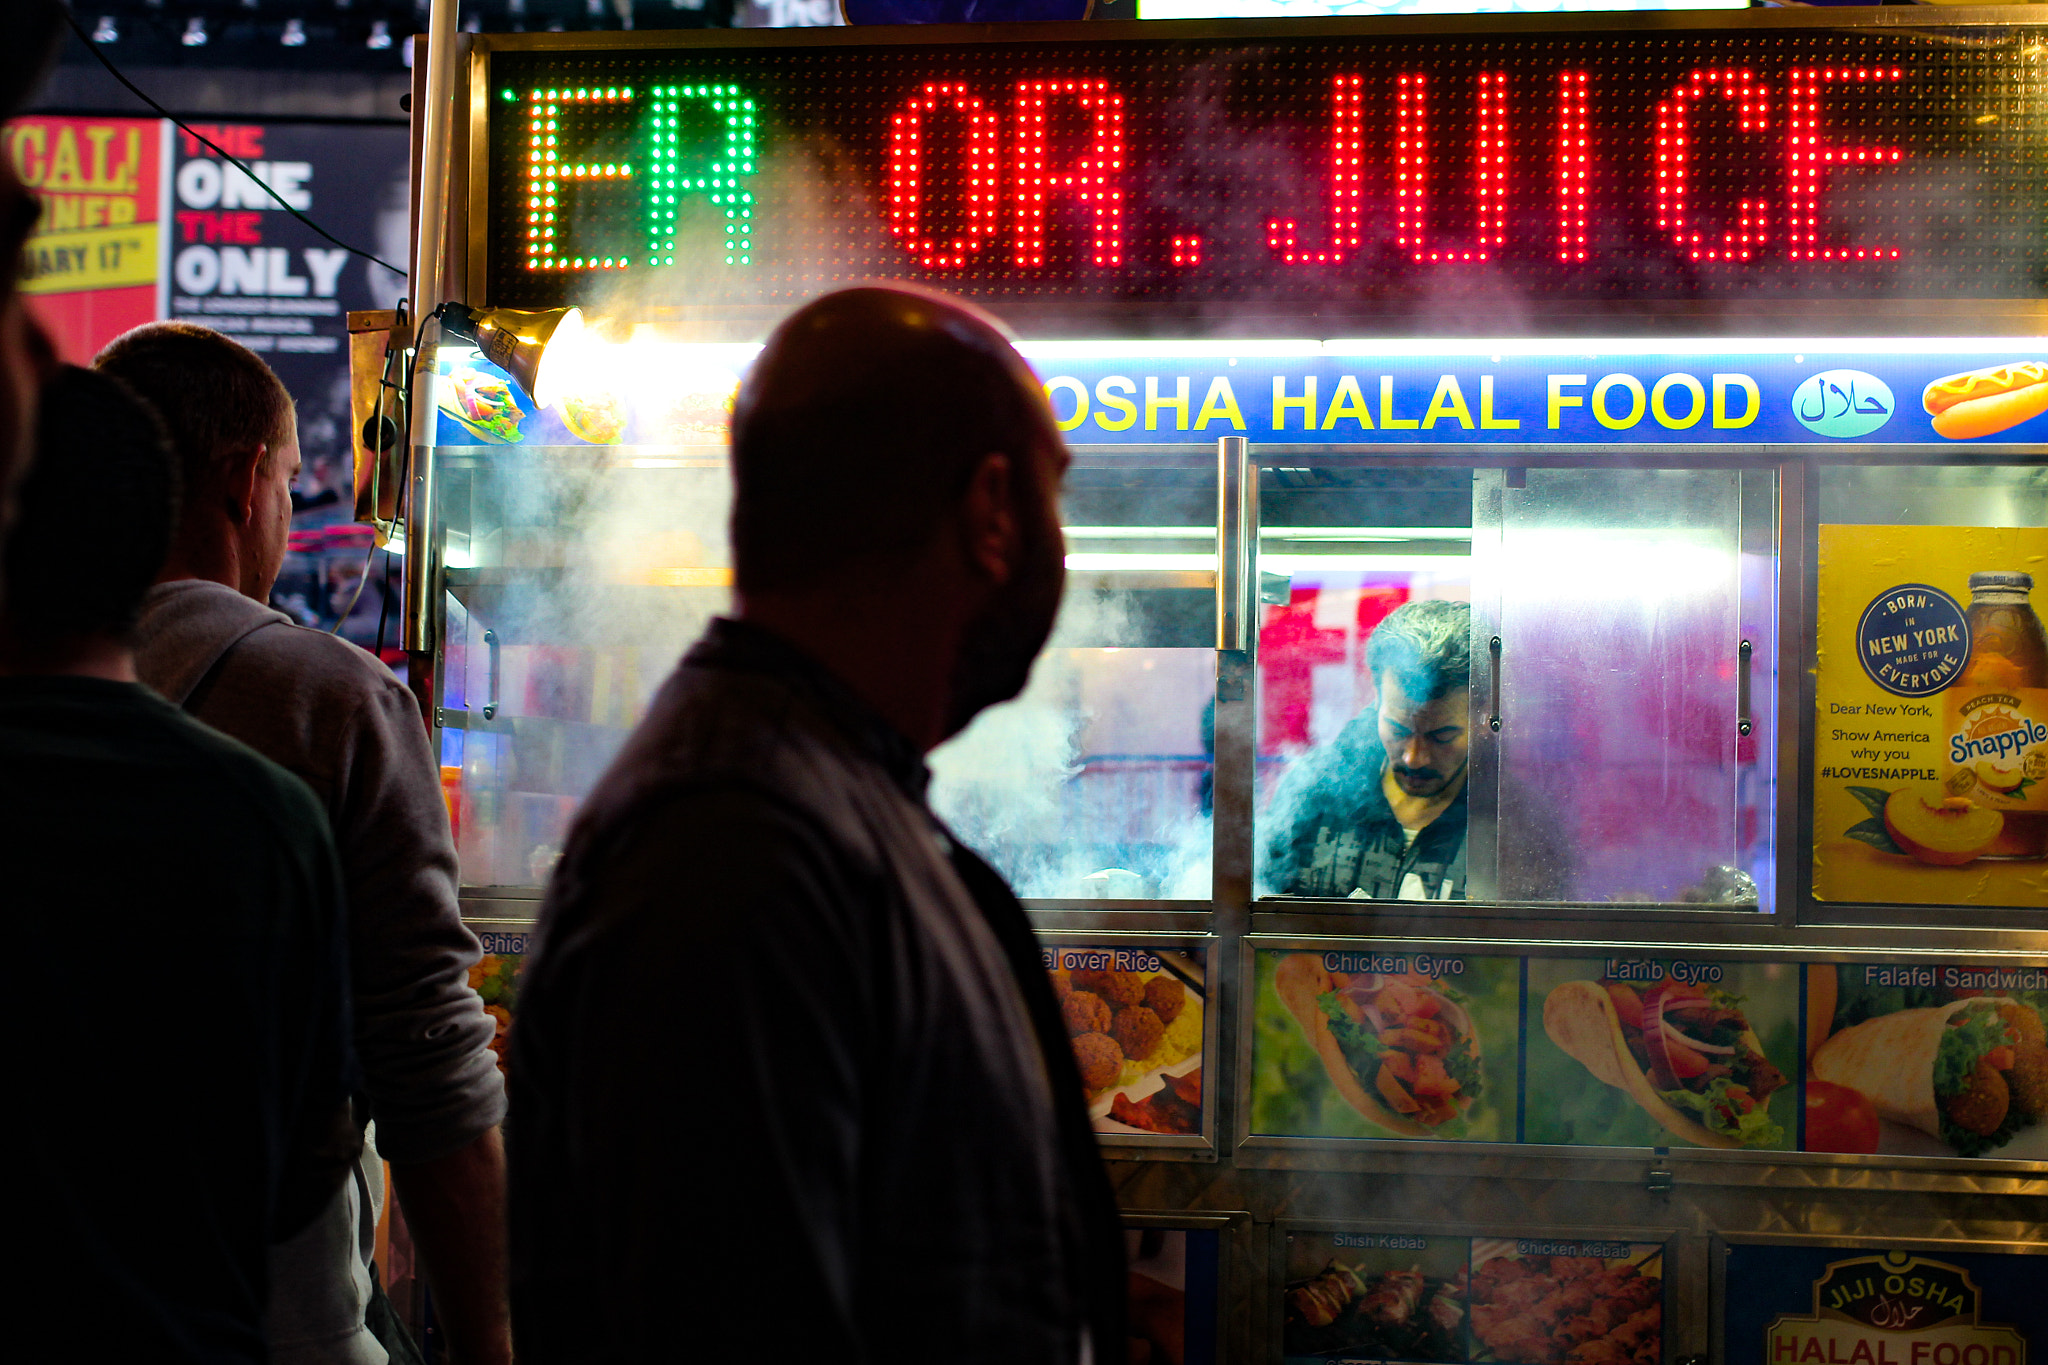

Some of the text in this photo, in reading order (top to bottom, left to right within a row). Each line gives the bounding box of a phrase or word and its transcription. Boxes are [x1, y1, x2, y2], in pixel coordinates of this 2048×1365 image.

[178, 125, 264, 158] THE
[2, 124, 141, 193] CAL!
[890, 80, 1200, 268] OR.
[1267, 68, 1901, 264] JUICE
[177, 159, 313, 210] ONE
[176, 211, 262, 244] THE
[175, 245, 348, 296] ONLY
[1043, 372, 1761, 432] OSHA HALAL FOOD
[1800, 377, 1888, 422] حلال
[1886, 594, 1927, 614] BORN
[1905, 617, 1915, 627] IN
[1868, 624, 1960, 656] NEW YORK
[1879, 653, 1958, 688] EVERYONE
[1896, 650, 1939, 665] MADE FOR
[1830, 703, 1933, 717] Dear New York,
[1966, 696, 2014, 711] PEACH TEA
[1832, 729, 1930, 742] Show America
[1950, 719, 2047, 763] Snapple
[1851, 747, 1910, 761] why you
[1821, 766, 1939, 781] #LOVESNAPPLE.
[1064, 953, 1110, 971] over
[1115, 950, 1160, 972] Rice
[1324, 951, 1465, 980] Chicken Gyro
[1606, 958, 1723, 986] Lamb Gyro
[1865, 965, 2048, 990] Falafel Sandwich
[1333, 1233, 1427, 1251] Shish Kebab
[1517, 1239, 1631, 1259] Chicken Kebab
[1830, 1274, 1967, 1316] JIJI OSHA
[1774, 1335, 2016, 1365] HALAL FOOD
